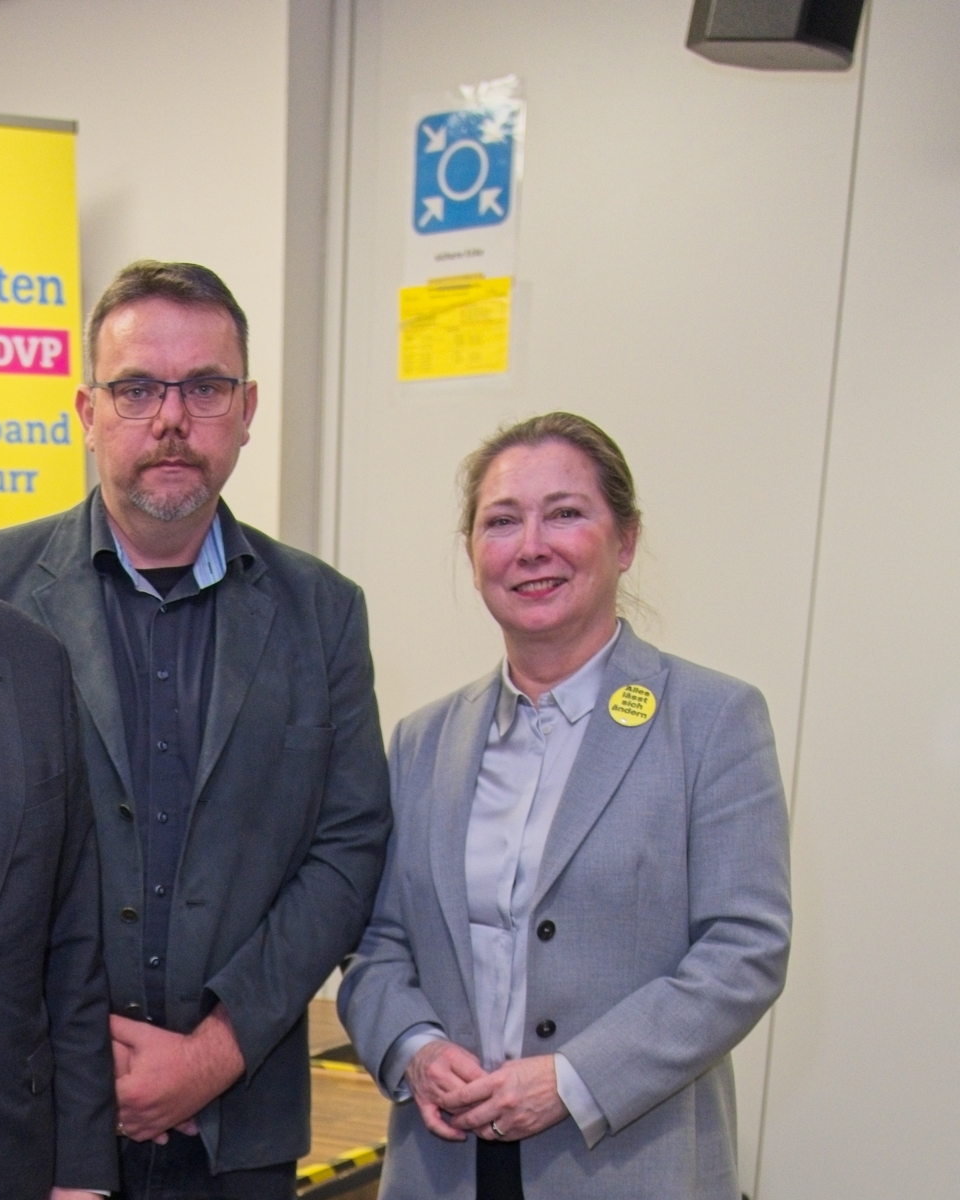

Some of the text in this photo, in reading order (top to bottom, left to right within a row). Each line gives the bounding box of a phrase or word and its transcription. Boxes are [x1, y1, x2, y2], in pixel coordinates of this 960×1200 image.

[625, 686, 650, 696] Alles
[622, 692, 648, 703] lässt
[622, 700, 643, 709] sich
[612, 705, 647, 718] ändern
